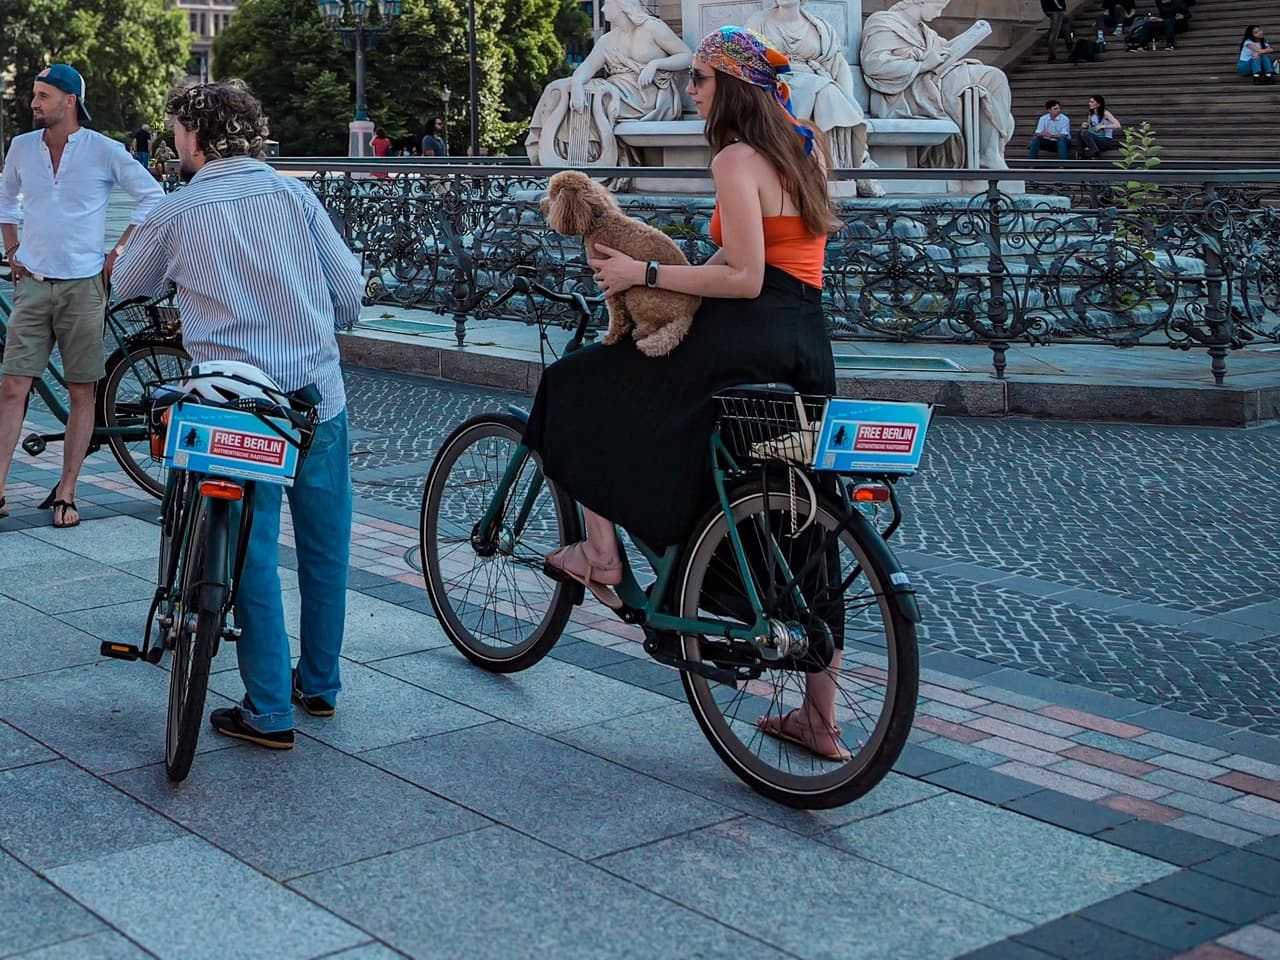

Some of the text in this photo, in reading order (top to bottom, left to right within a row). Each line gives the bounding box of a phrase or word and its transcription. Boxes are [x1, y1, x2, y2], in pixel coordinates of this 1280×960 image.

[858, 426, 913, 440] FREE BERLIN
[214, 432, 281, 453] FREE BERLIN
